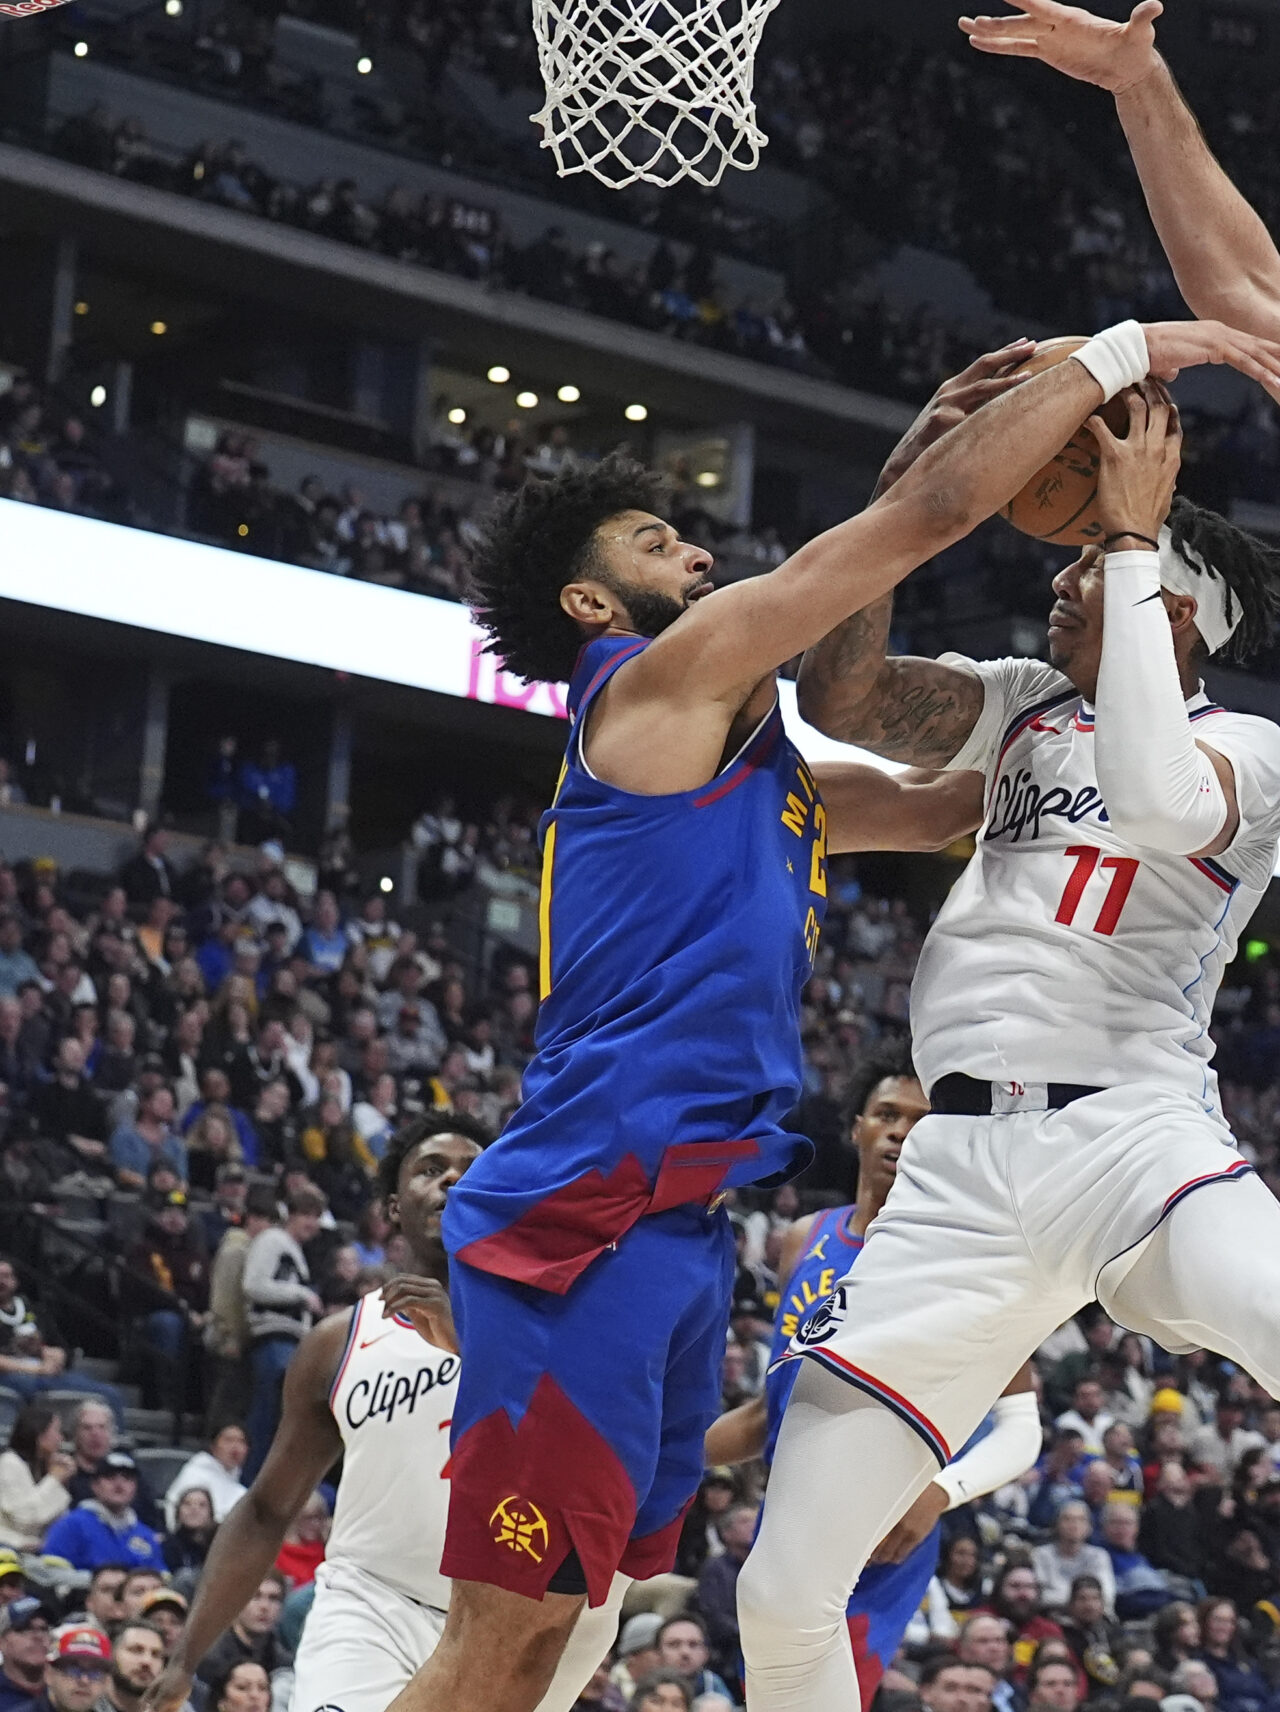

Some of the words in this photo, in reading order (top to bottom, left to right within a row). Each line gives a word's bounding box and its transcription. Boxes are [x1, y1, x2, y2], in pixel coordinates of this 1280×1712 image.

[984, 768, 1109, 842] Clippe
[1054, 845, 1140, 936] 11
[781, 1269, 835, 1336] MILE
